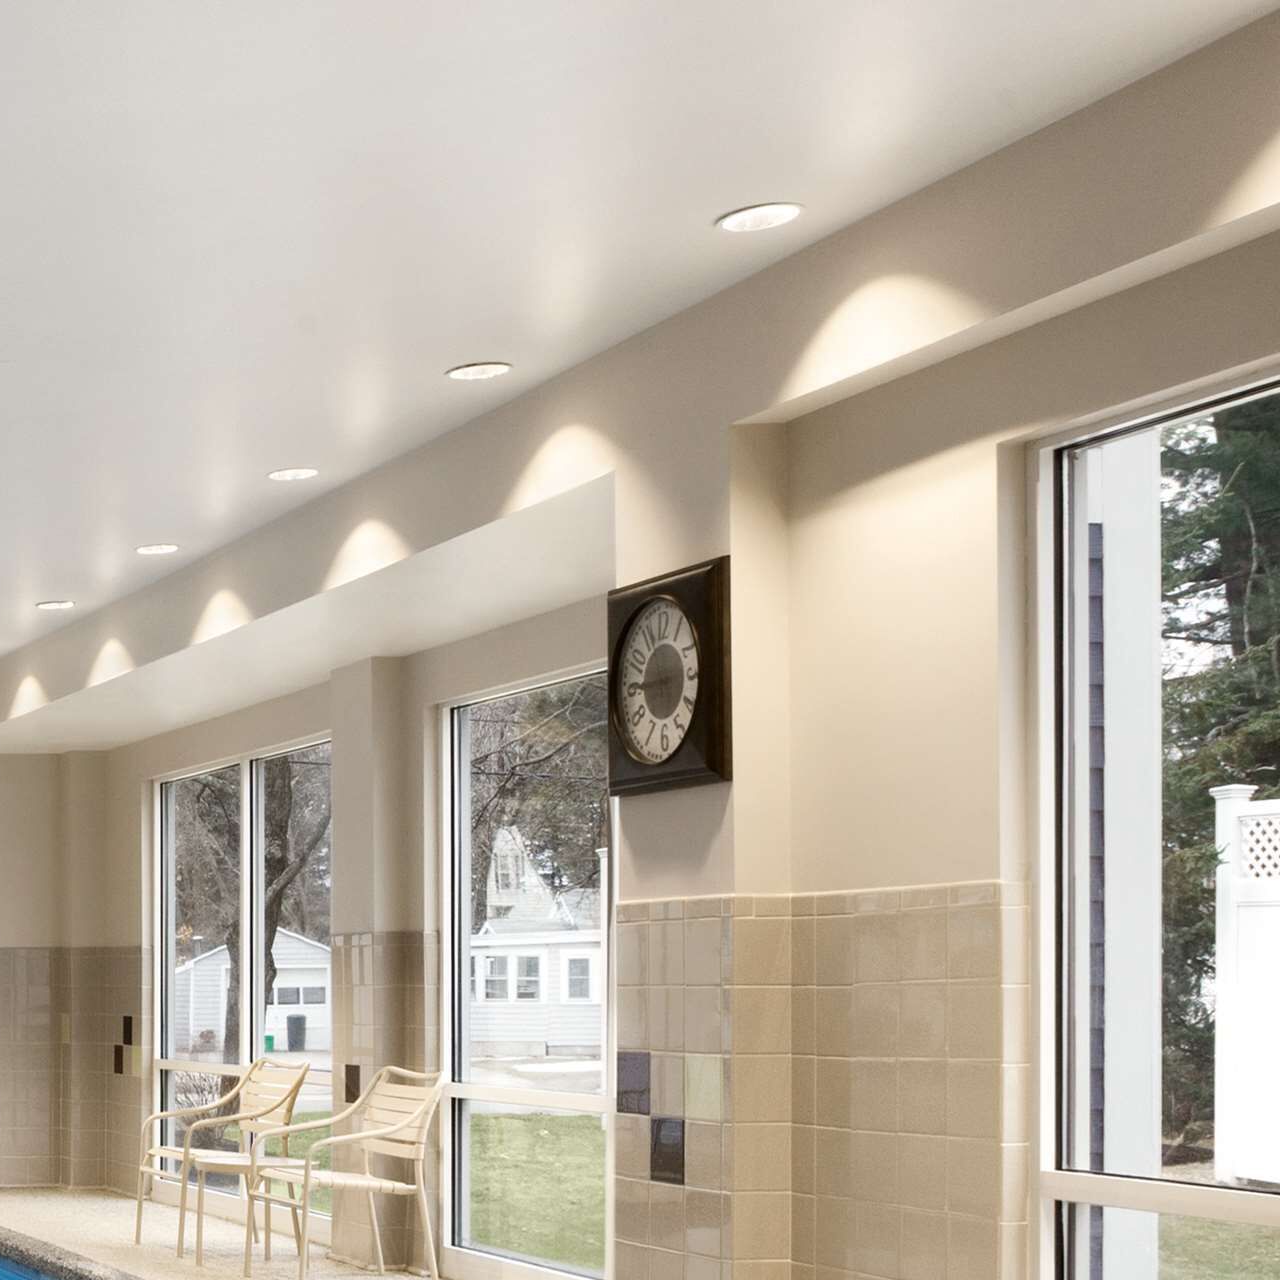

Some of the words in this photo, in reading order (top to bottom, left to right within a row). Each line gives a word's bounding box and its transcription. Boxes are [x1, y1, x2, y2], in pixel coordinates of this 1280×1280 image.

[642, 622, 655, 652] 11
[658, 611, 669, 641] 12
[673, 616, 684, 642] 1
[630, 649, 647, 674] 10
[627, 682, 645, 697] 9
[631, 704, 646, 728] 8
[673, 714, 686, 740] 5
[645, 720, 656, 747] 7
[660, 723, 670, 752] 6
